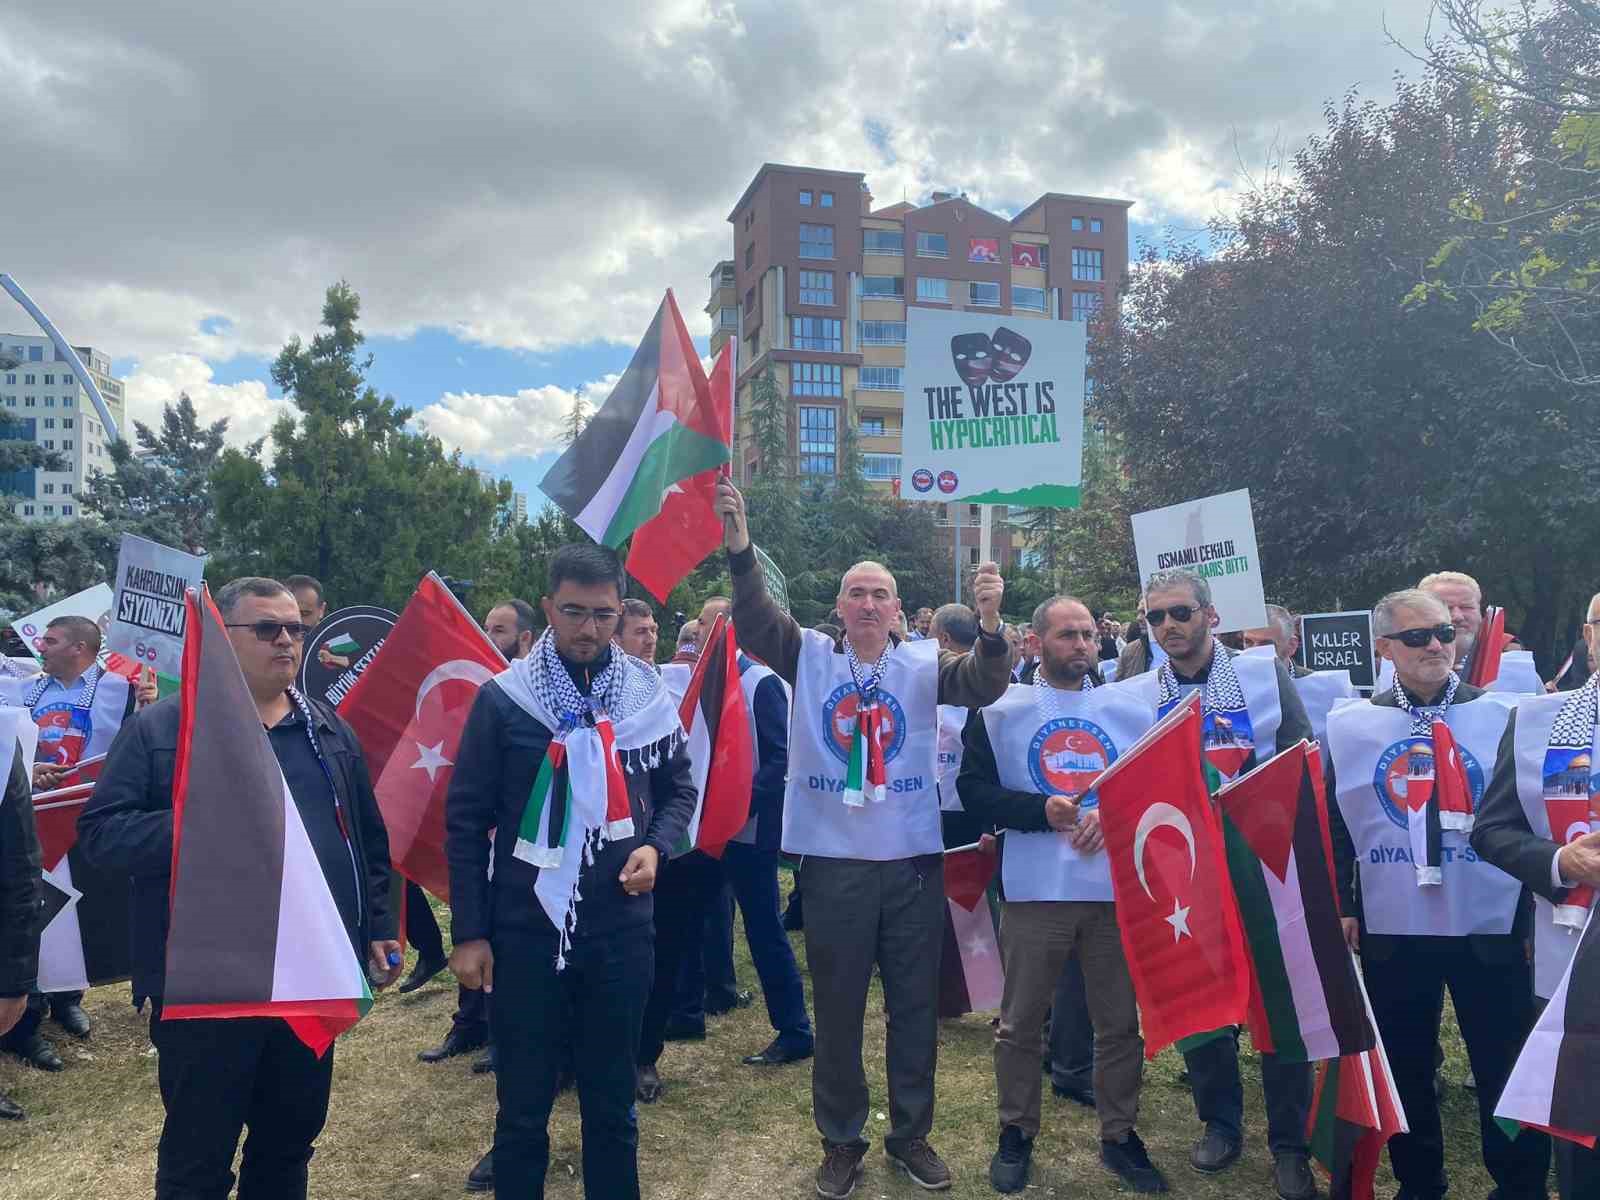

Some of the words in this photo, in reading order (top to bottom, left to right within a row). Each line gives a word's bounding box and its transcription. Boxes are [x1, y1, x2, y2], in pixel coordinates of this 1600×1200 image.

[924, 386, 963, 420] THE
[968, 383, 1028, 417] WEST
[1035, 381, 1056, 414] IS
[929, 413, 1060, 450] HYPOCRITICAL
[1157, 547, 1198, 570] OSMANLI
[125, 565, 187, 600] KAHROLSUN
[1311, 632, 1362, 648] KILLER
[1313, 651, 1363, 667] ISRAEL
